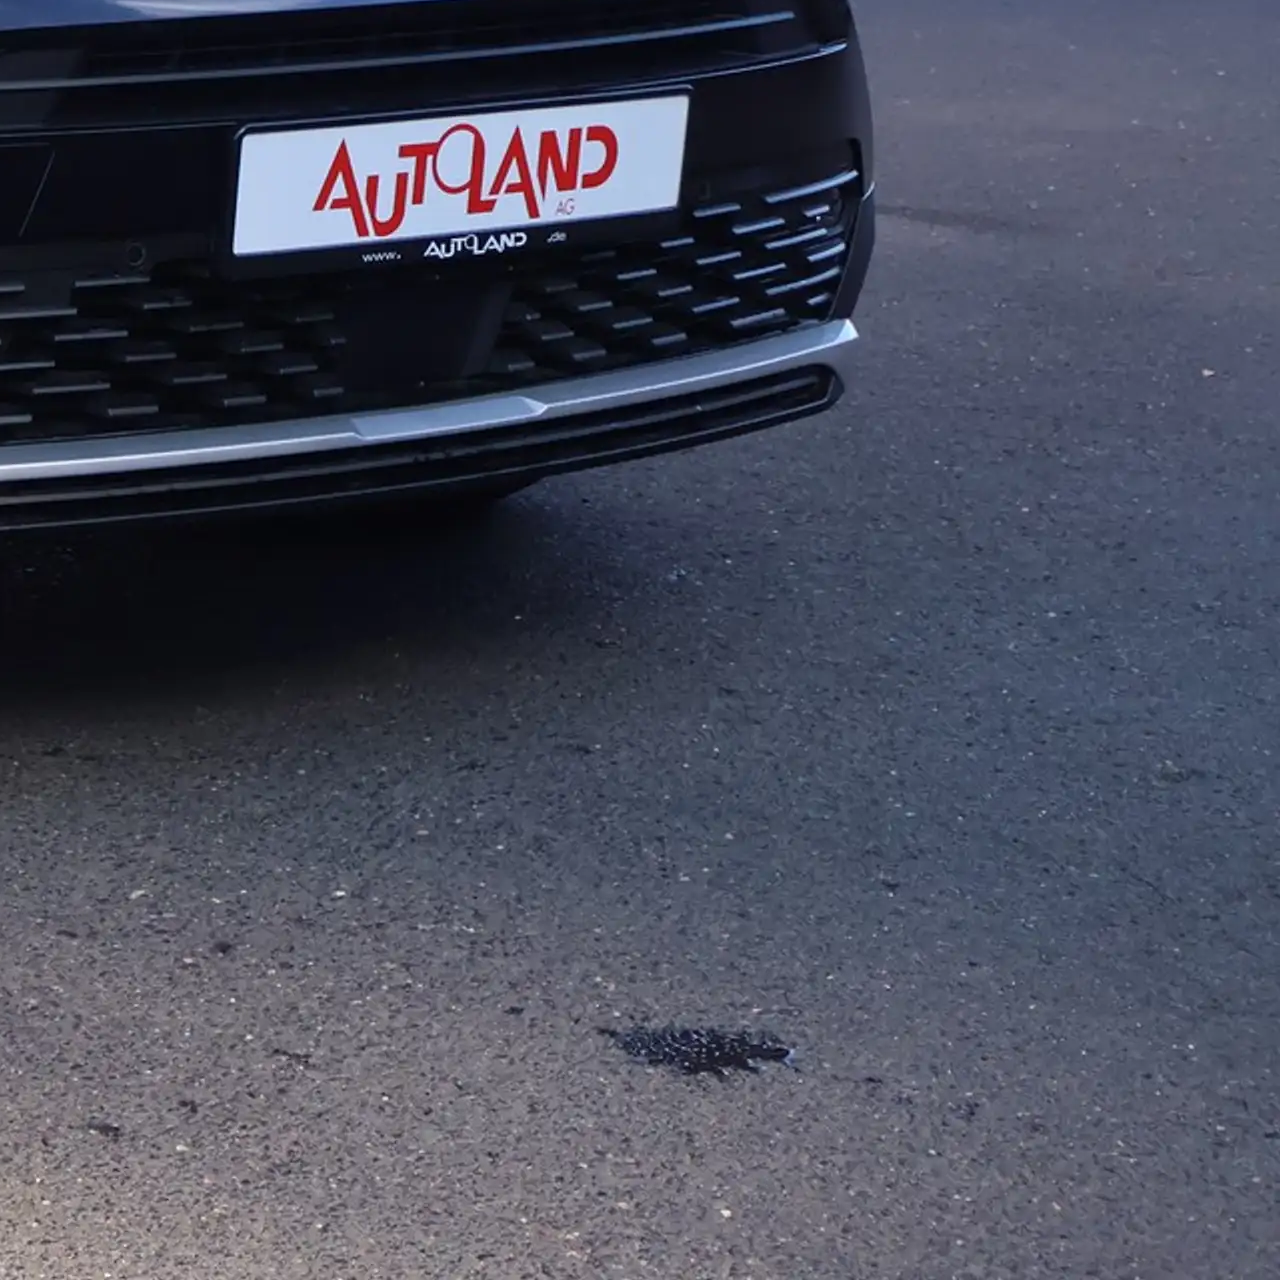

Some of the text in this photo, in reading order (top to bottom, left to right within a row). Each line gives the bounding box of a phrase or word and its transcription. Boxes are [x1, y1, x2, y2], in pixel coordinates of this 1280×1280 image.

[312, 122, 619, 237] AUTOLAND
[555, 198, 576, 217] AG
[423, 231, 528, 259] AUTOLAND
